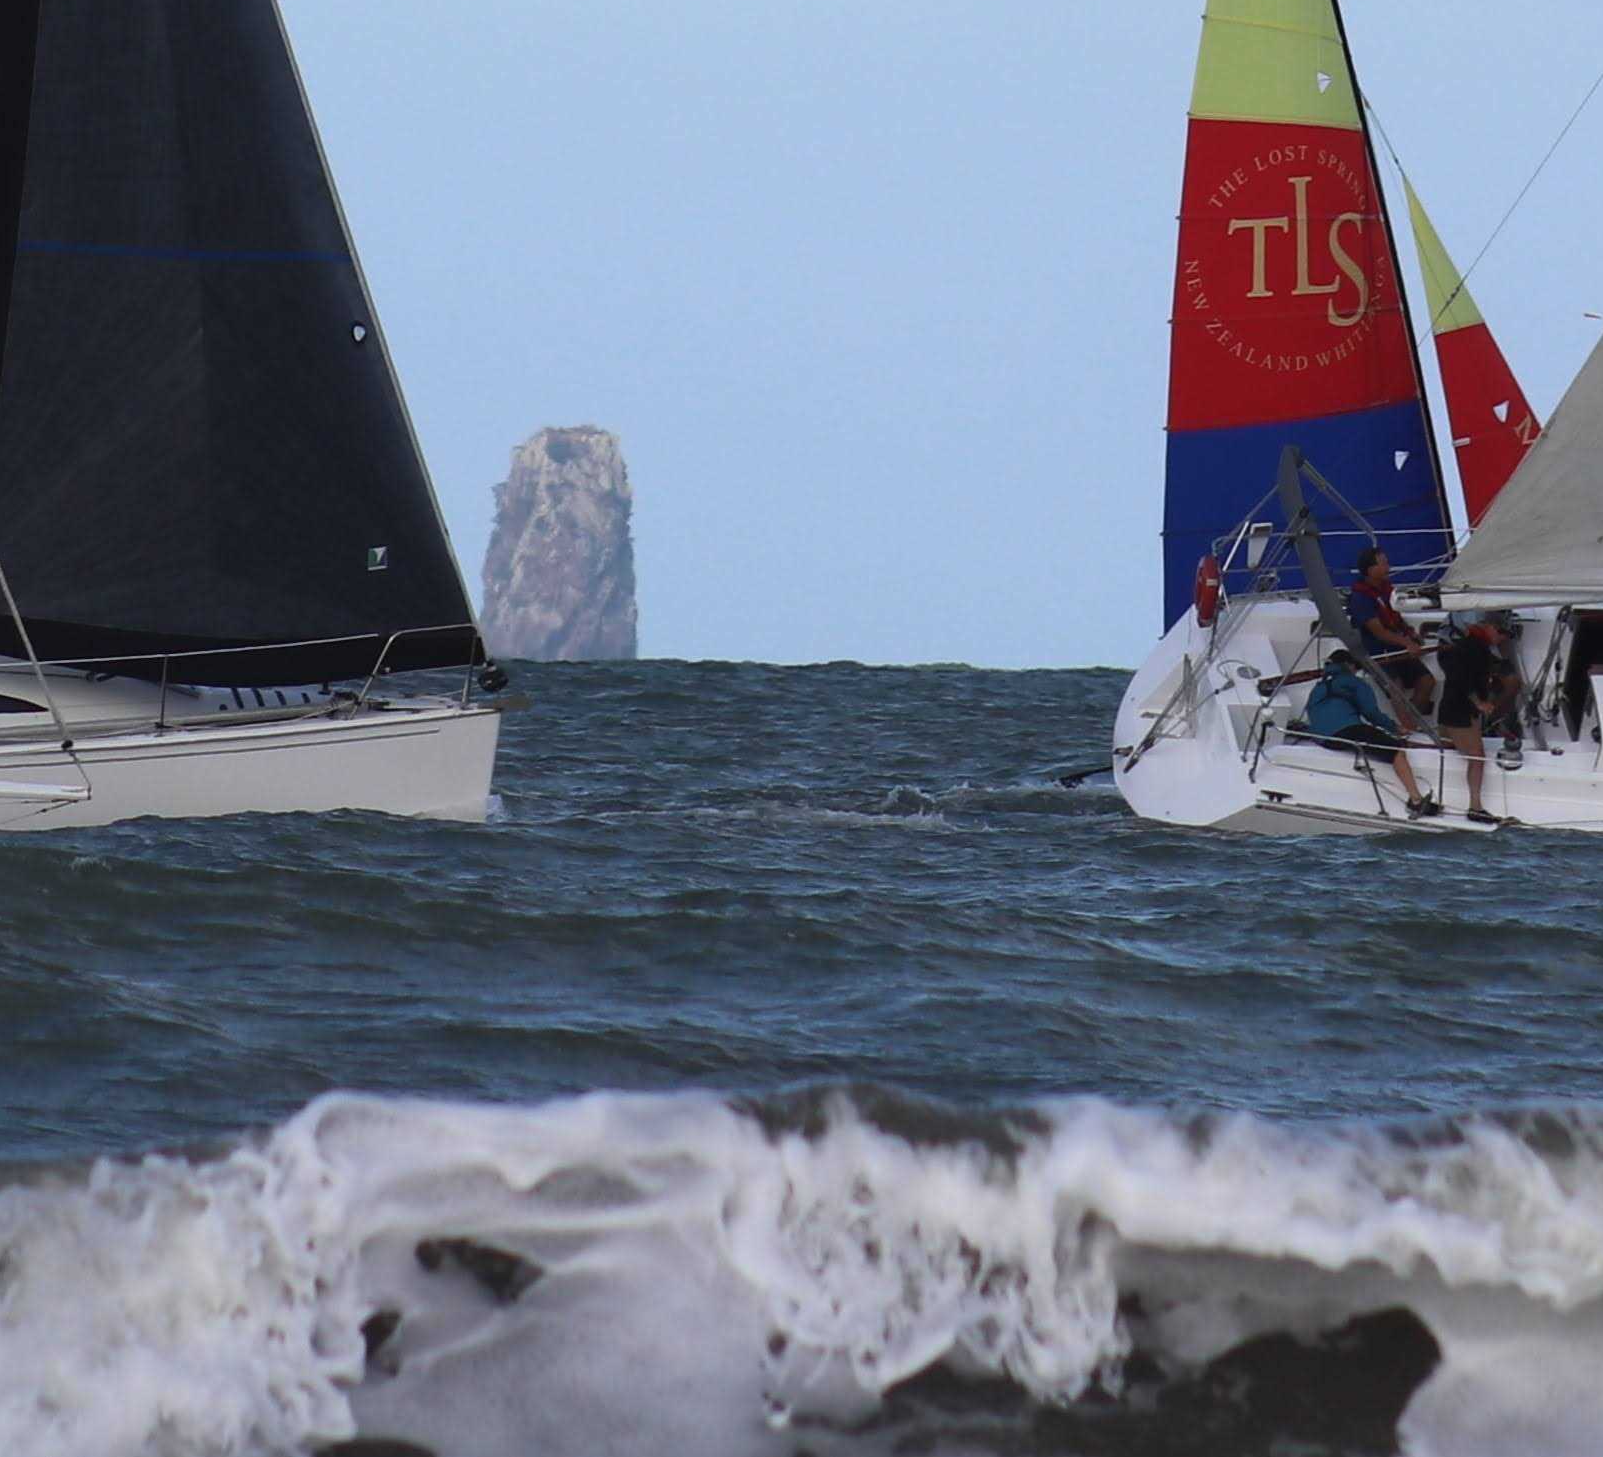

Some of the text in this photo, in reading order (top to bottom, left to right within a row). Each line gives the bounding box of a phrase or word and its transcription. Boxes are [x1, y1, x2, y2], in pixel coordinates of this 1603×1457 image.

[1208, 168, 1248, 208] THE
[1254, 145, 1308, 171] LOST
[1228, 176, 1369, 327] TLS
[1184, 260, 1210, 310] NEW
[1205, 318, 1309, 371] ZEALAND
